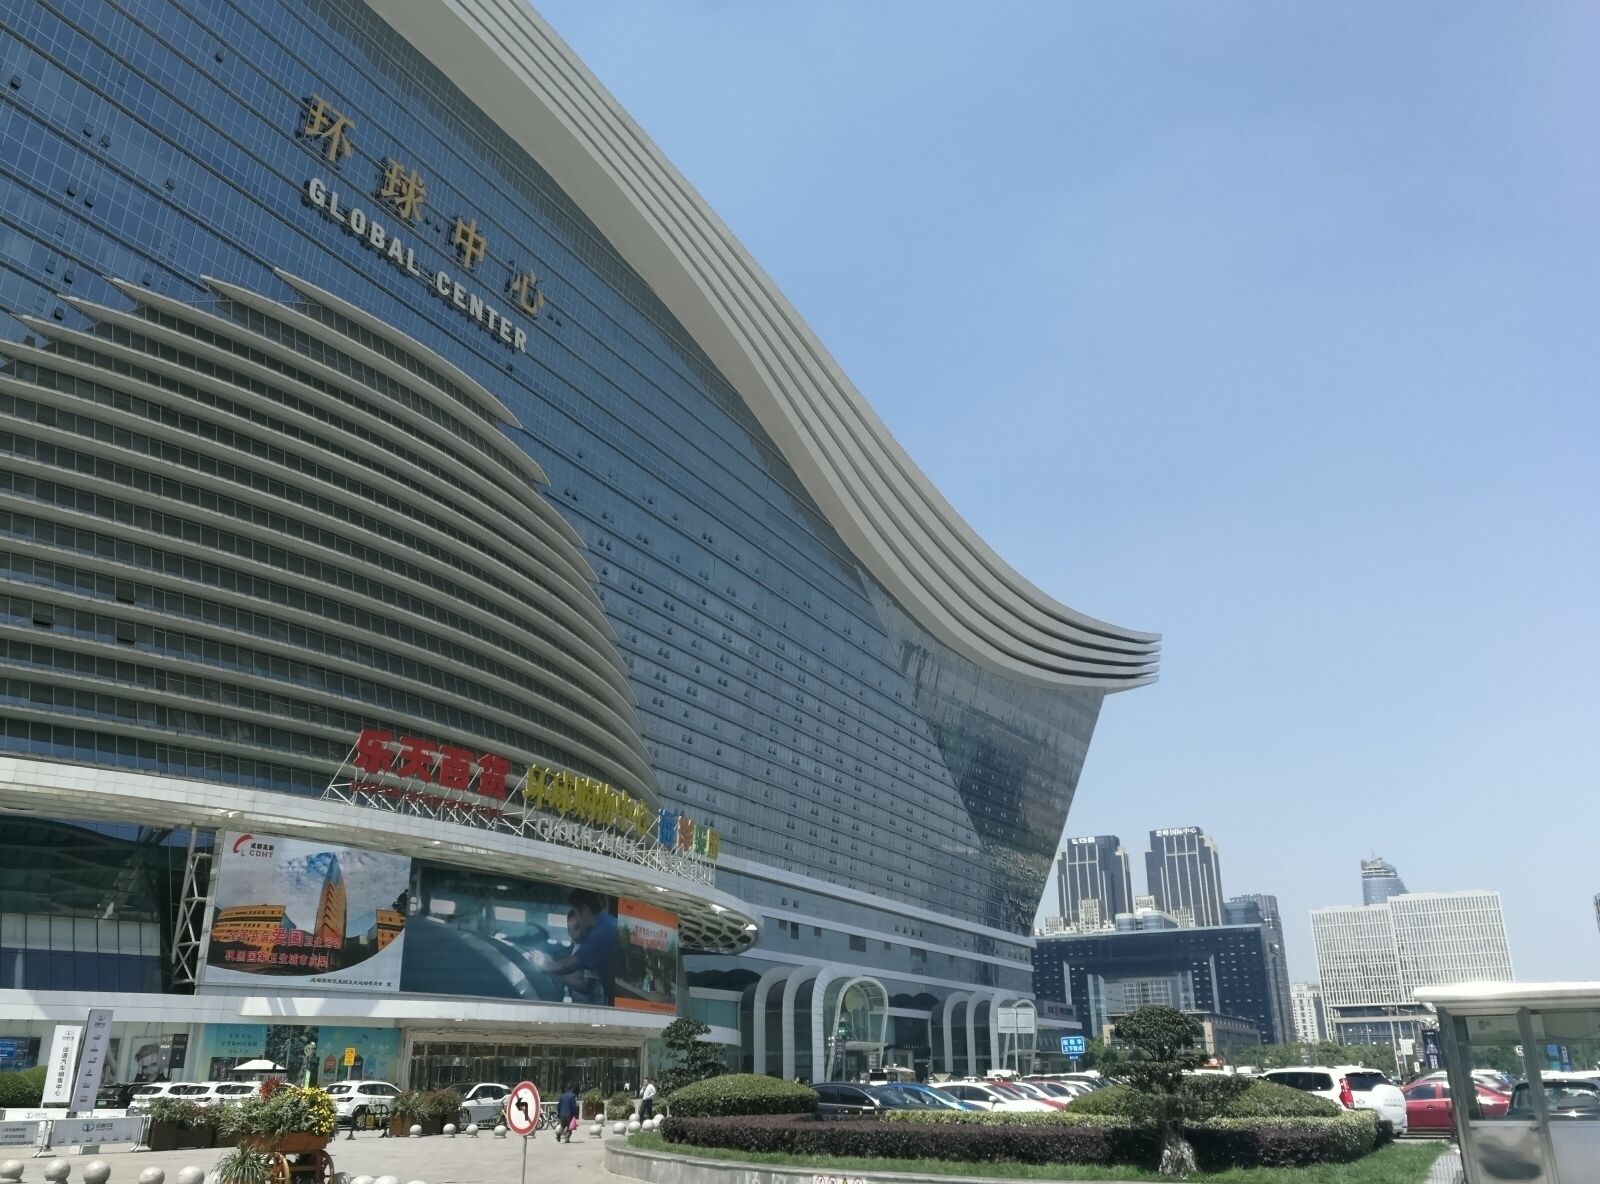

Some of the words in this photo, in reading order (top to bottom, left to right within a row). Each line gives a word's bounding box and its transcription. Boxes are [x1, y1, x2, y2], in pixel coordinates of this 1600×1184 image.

[303, 93, 545, 316] 环球中心
[308, 178, 421, 277] GLOBAL
[436, 271, 527, 353] CENTER
[353, 729, 510, 801] 乐天百货
[249, 850, 274, 858] CDHT
